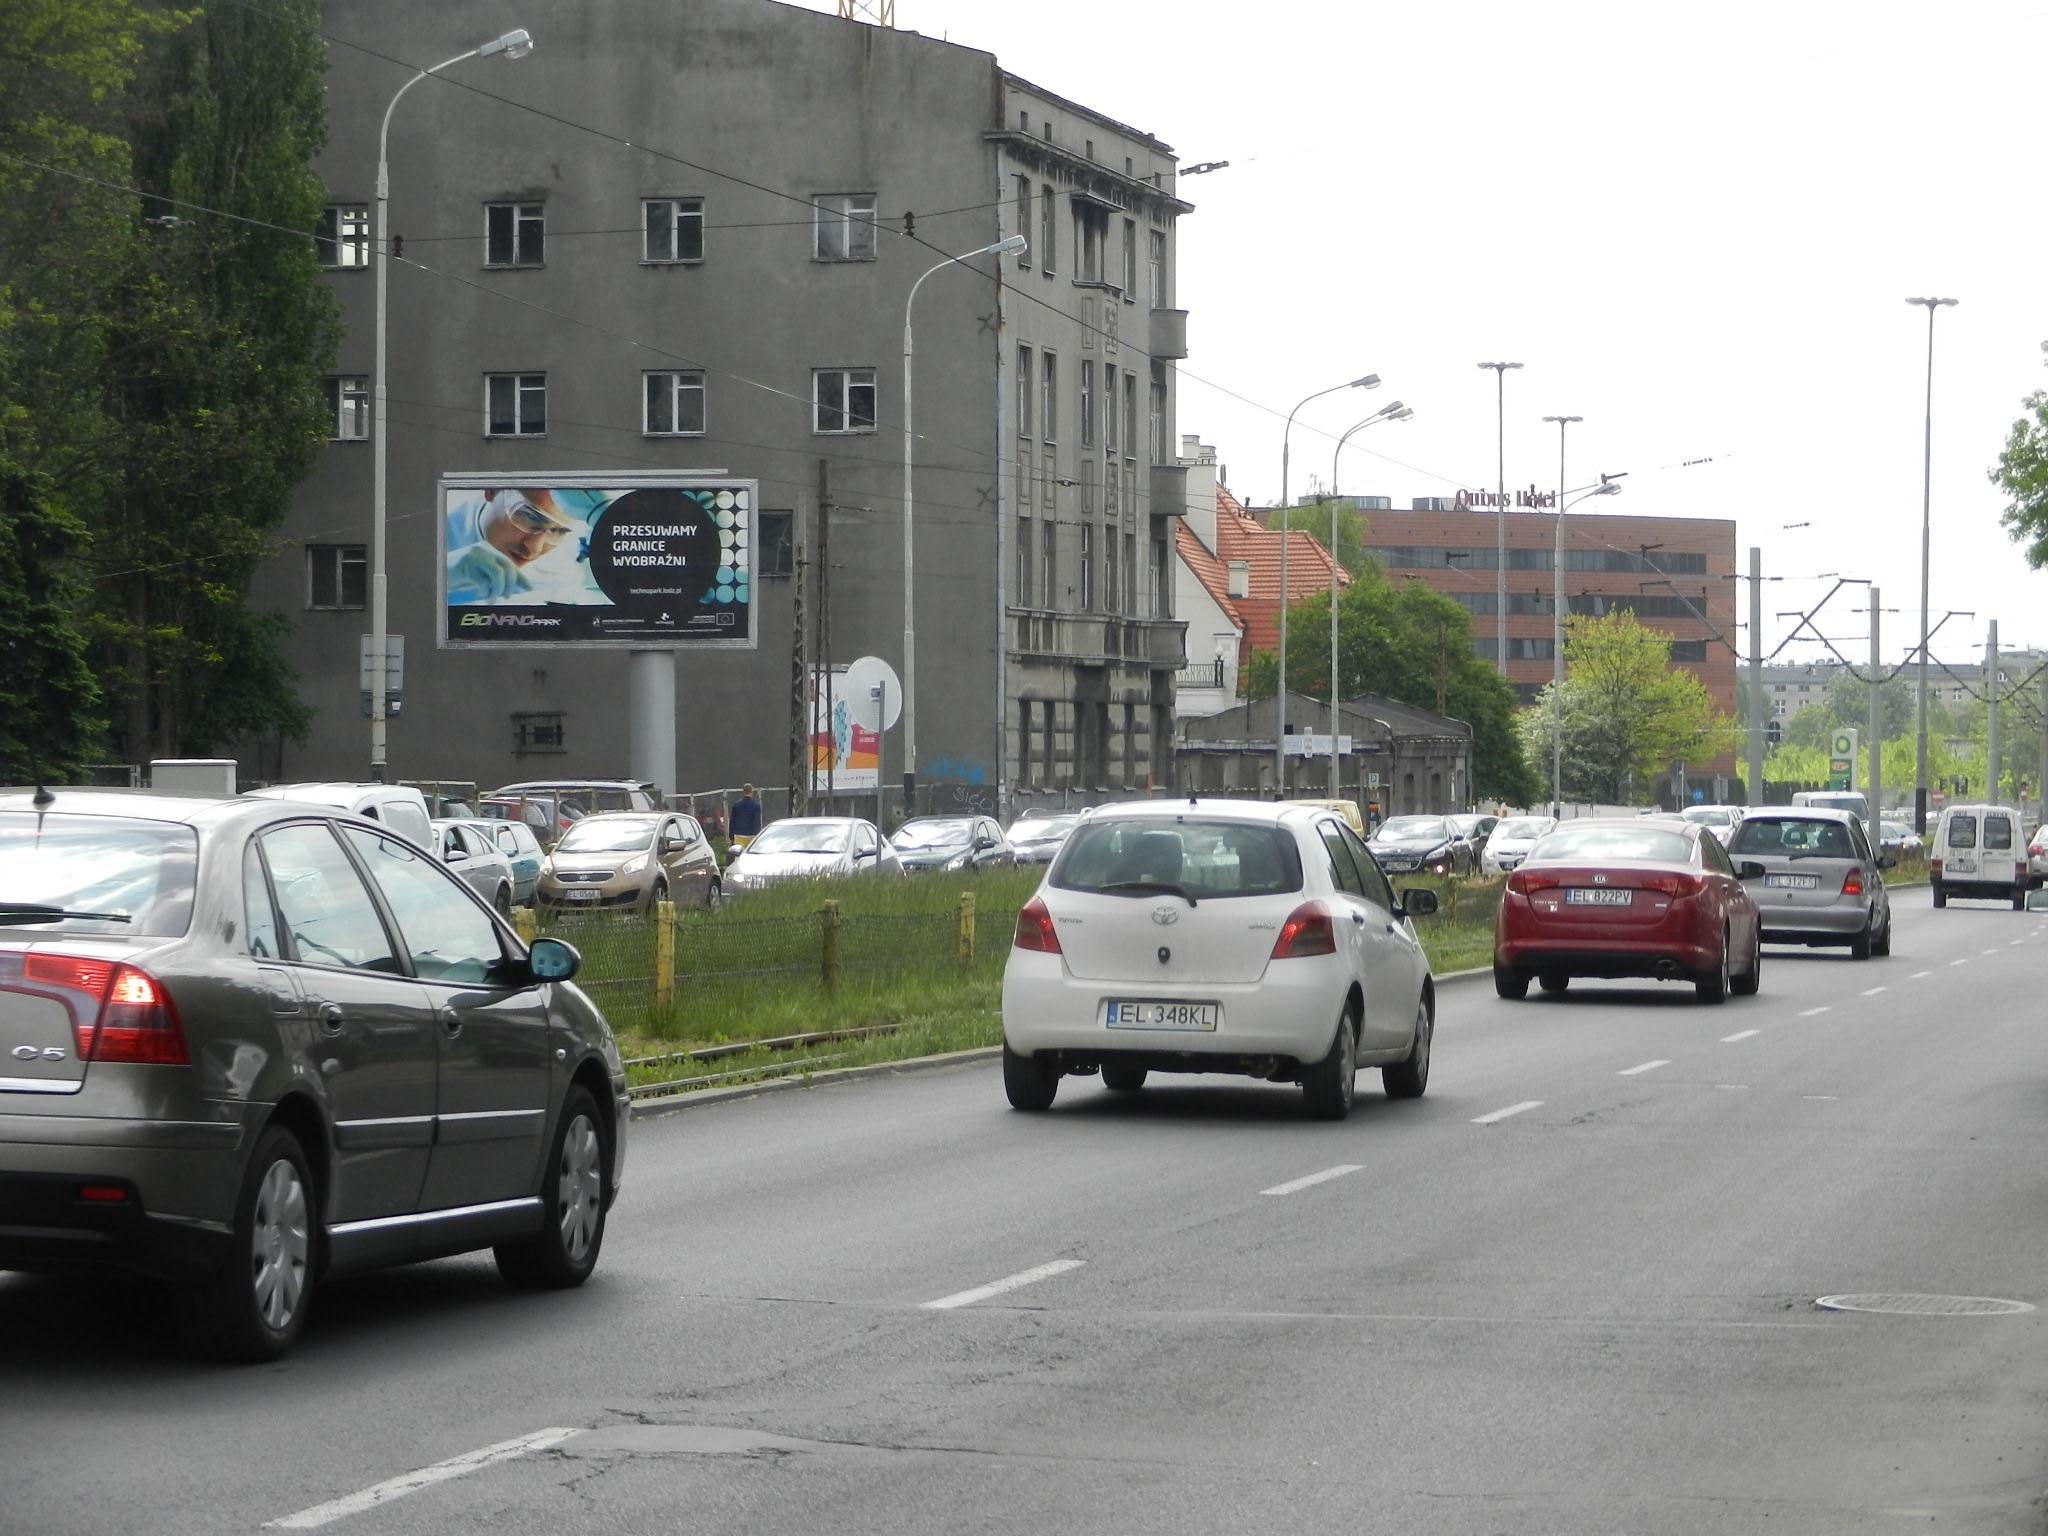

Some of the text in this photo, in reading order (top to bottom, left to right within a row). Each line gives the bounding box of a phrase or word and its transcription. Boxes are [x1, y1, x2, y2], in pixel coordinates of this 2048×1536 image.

[613, 525, 698, 536] PRZESUWAMY
[613, 540, 666, 552] GRANICE
[613, 553, 686, 567] WYOBRAŹNI
[1120, 1005, 1212, 1025] EL 348KL
[12, 1045, 66, 1062] C5
